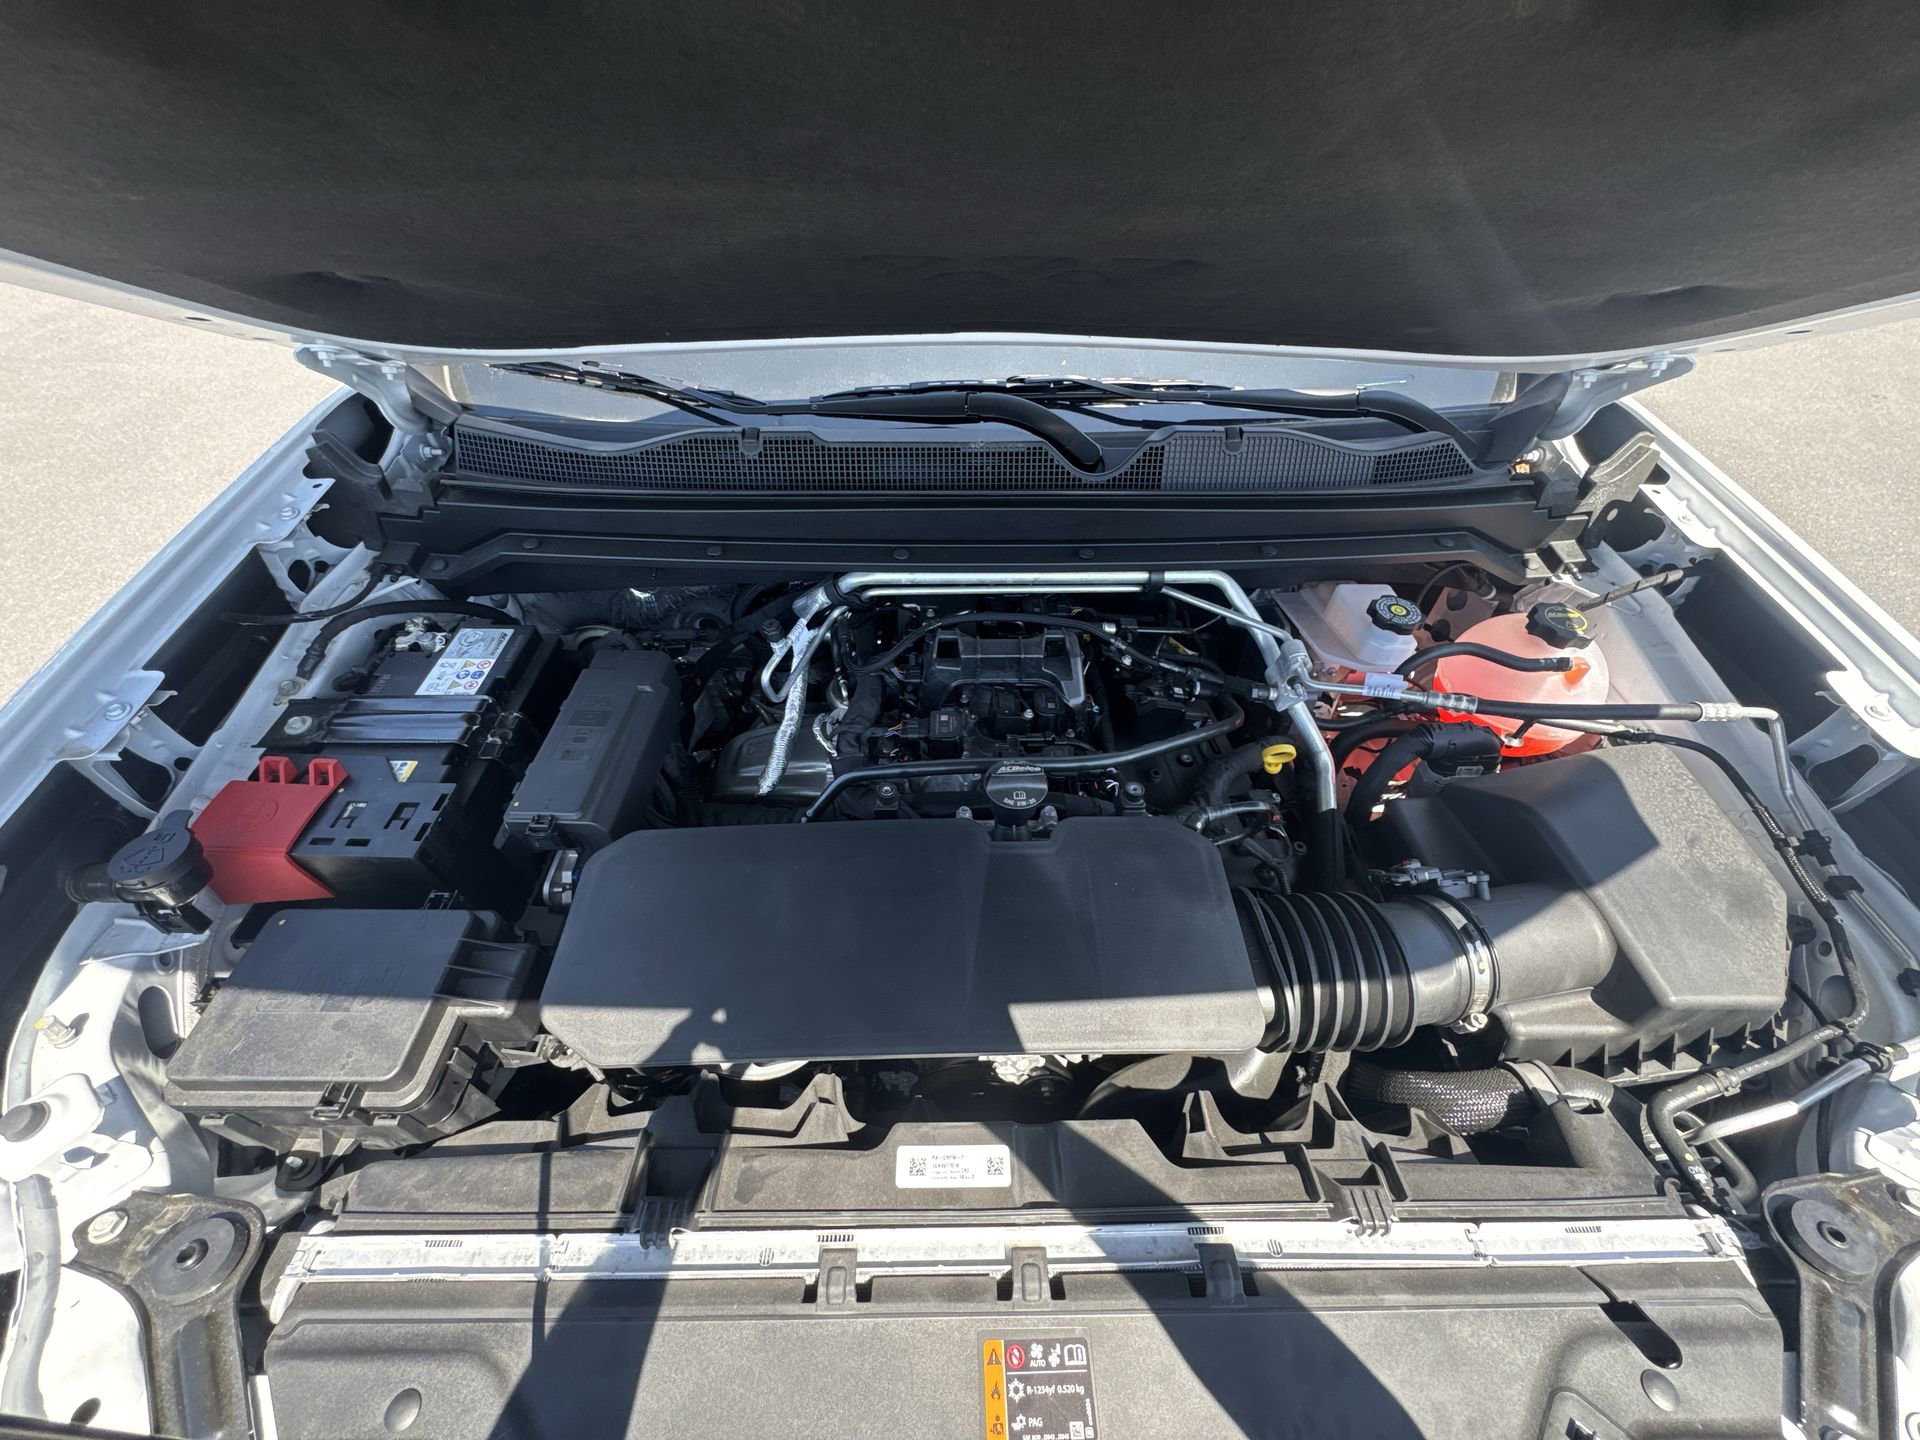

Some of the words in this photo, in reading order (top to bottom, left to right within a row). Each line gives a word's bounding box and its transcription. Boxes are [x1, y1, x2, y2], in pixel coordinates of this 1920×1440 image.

[996, 765, 1041, 774] ACDelco
[1030, 1360, 1046, 1368] AUTO
[1026, 1384, 1056, 1397] R-1234yf
[1057, 1384, 1075, 1394] 0.520
[1075, 1384, 1085, 1395] kg
[1028, 1417, 1043, 1427] PAG
